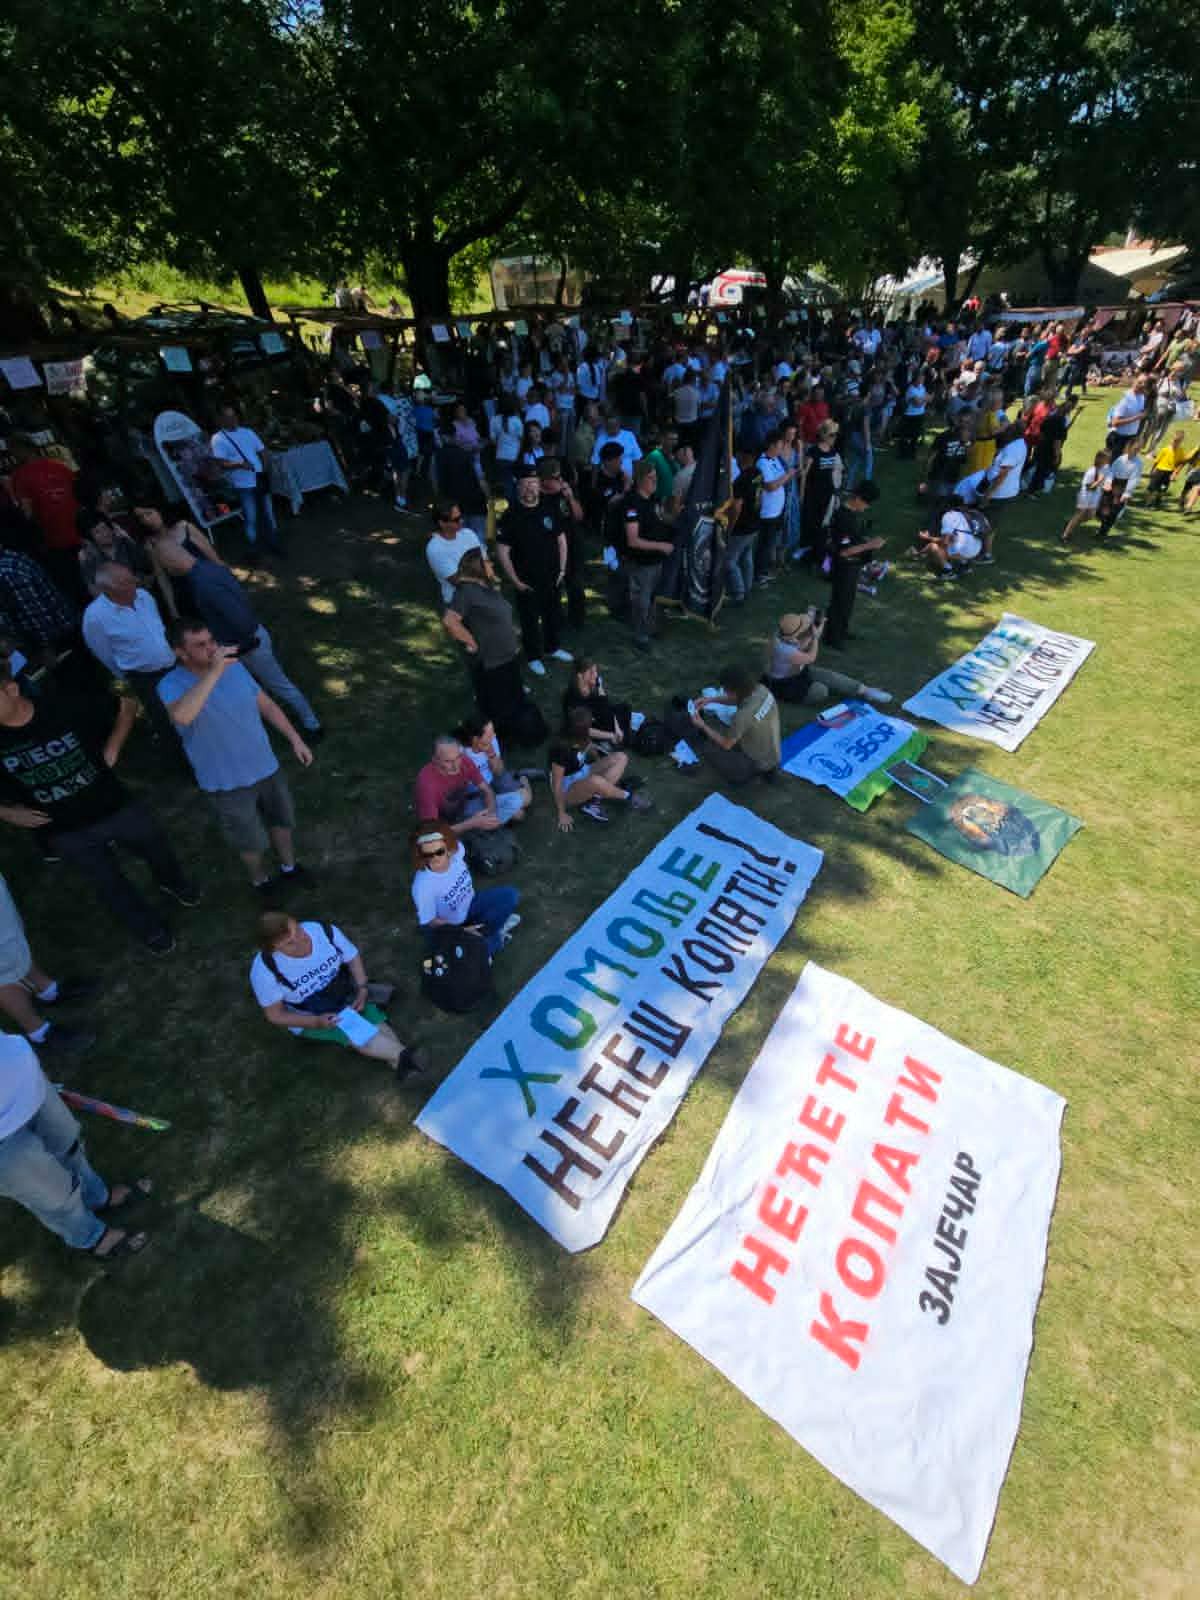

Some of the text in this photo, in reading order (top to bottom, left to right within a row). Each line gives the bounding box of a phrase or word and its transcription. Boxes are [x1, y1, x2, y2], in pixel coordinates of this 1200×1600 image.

[522, 1001, 692, 1211] НЕЋЕШ
[730, 1023, 876, 1305] НЕЋЕТЕ
[810, 1055, 943, 1371] КОПАТИ
[919, 1151, 982, 1326] ЗАЈЕЧАР
